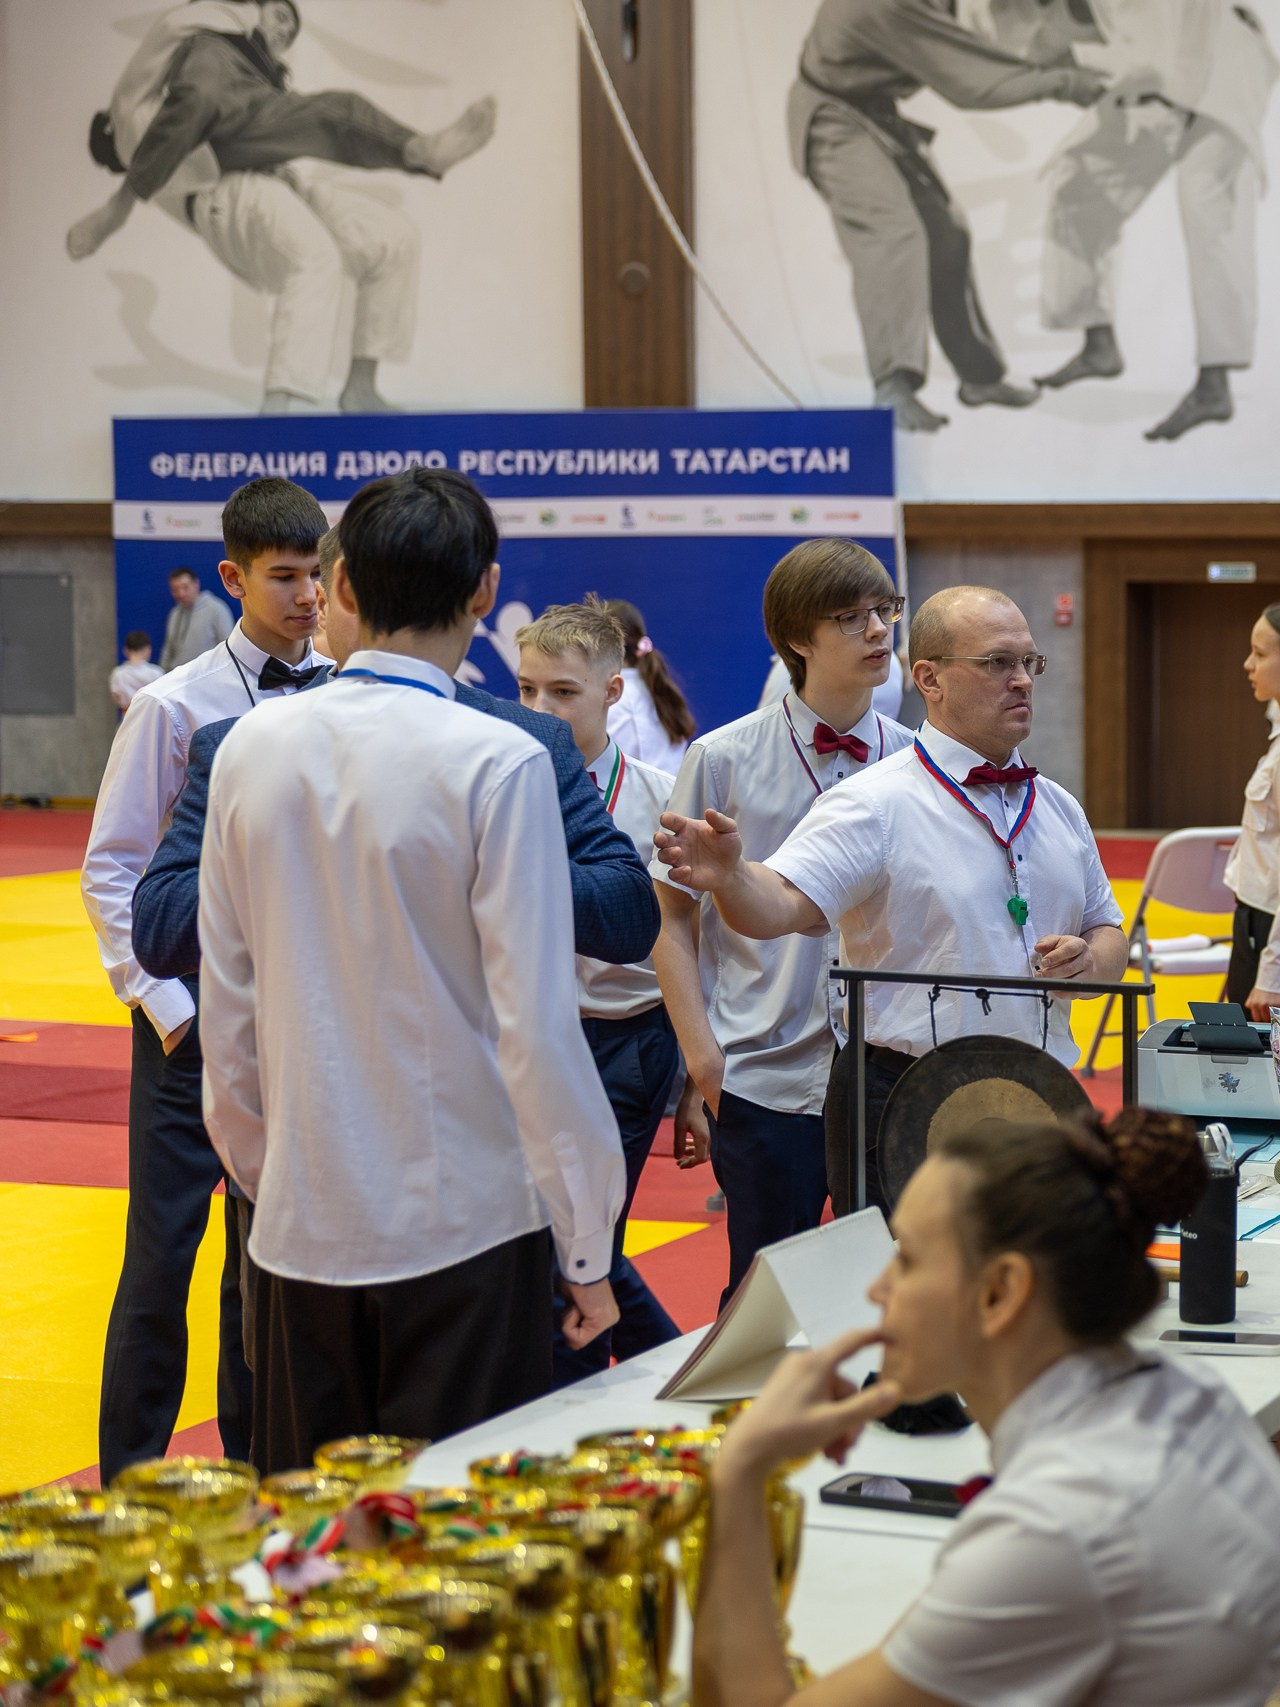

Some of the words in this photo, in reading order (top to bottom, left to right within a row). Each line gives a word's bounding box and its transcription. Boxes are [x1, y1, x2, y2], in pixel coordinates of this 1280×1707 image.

[150, 451, 328, 481] ФЕДЕРАЦИЯ
[459, 449, 659, 476] РЕСПУБЛИКИ
[671, 447, 850, 475] ТАТАРСТАН
